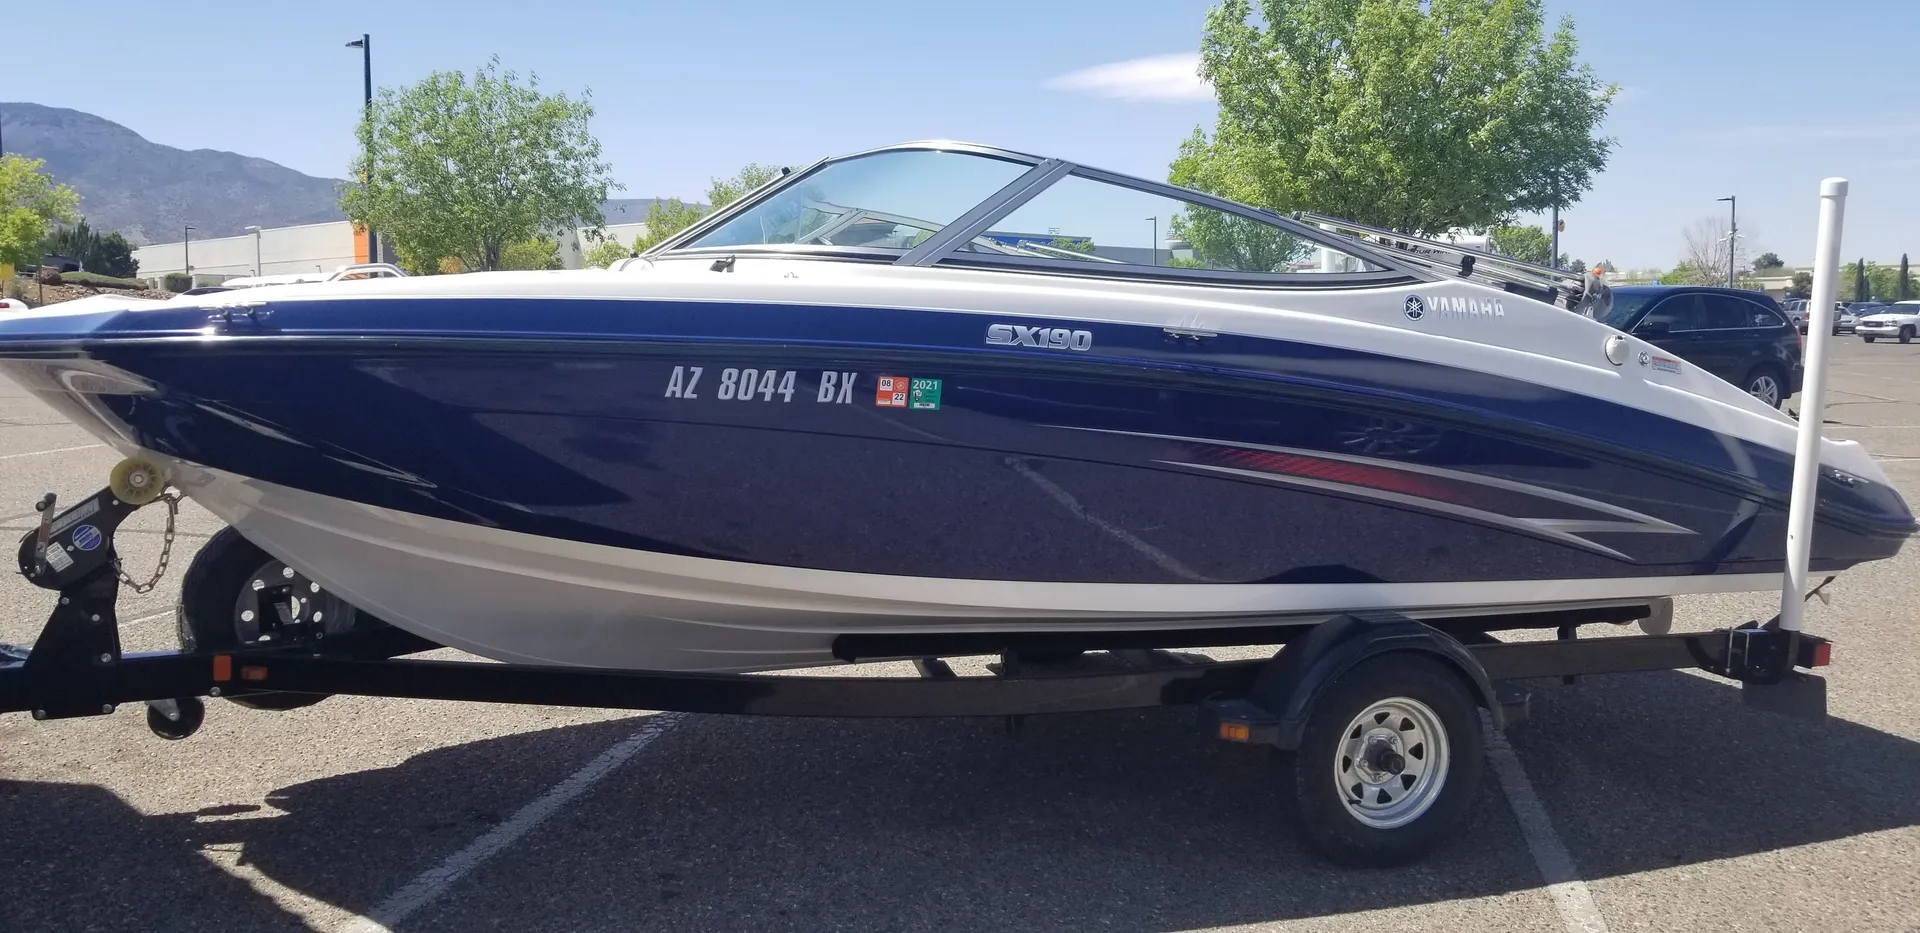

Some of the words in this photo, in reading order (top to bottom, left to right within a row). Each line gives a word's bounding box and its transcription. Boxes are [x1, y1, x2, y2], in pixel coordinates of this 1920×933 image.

[1427, 296, 1505, 317] YAMAHA
[985, 323, 1093, 351] SX190
[665, 365, 703, 399] AZ
[717, 368, 797, 402] 8044
[817, 371, 858, 404] BX
[881, 379, 892, 387] 08
[912, 380, 938, 390] 2021
[894, 393, 904, 401] 22
